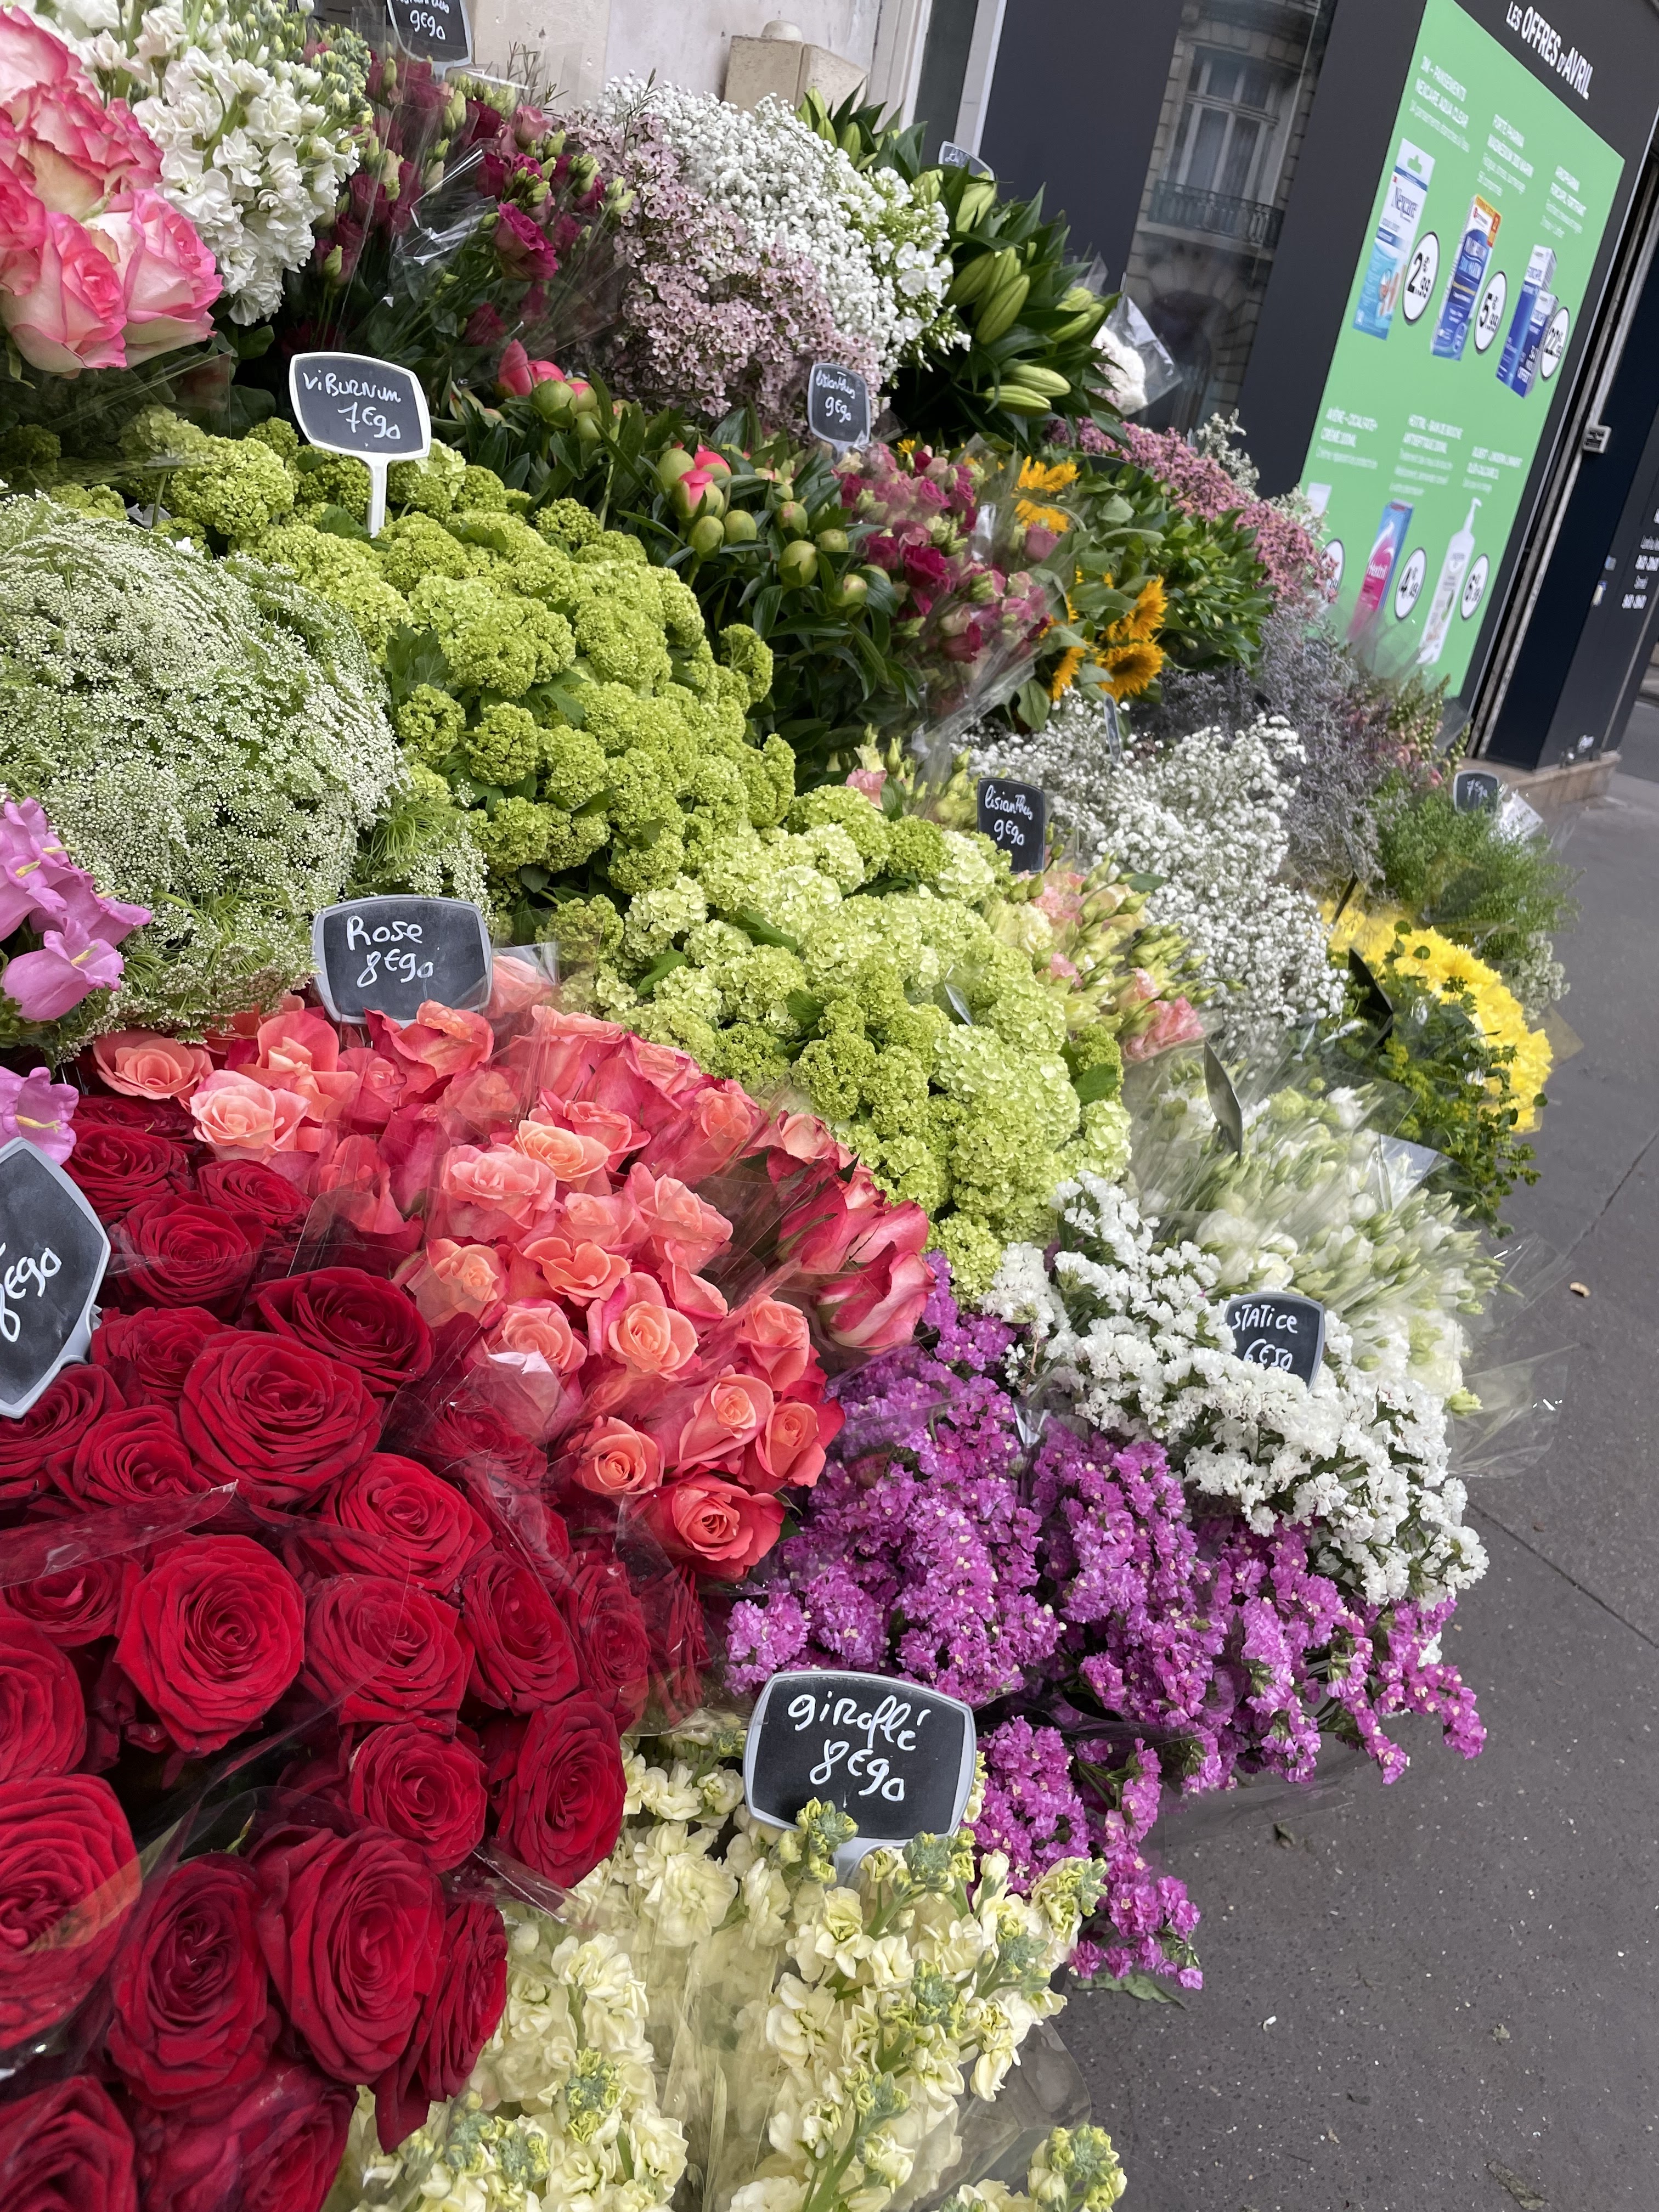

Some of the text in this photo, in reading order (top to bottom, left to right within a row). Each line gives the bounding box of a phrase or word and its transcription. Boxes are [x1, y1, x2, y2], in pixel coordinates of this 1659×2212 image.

[1505, 1, 1522, 31] LES
[1521, 6, 1562, 66] OFFRES
[346, 915, 423, 951] Rose
